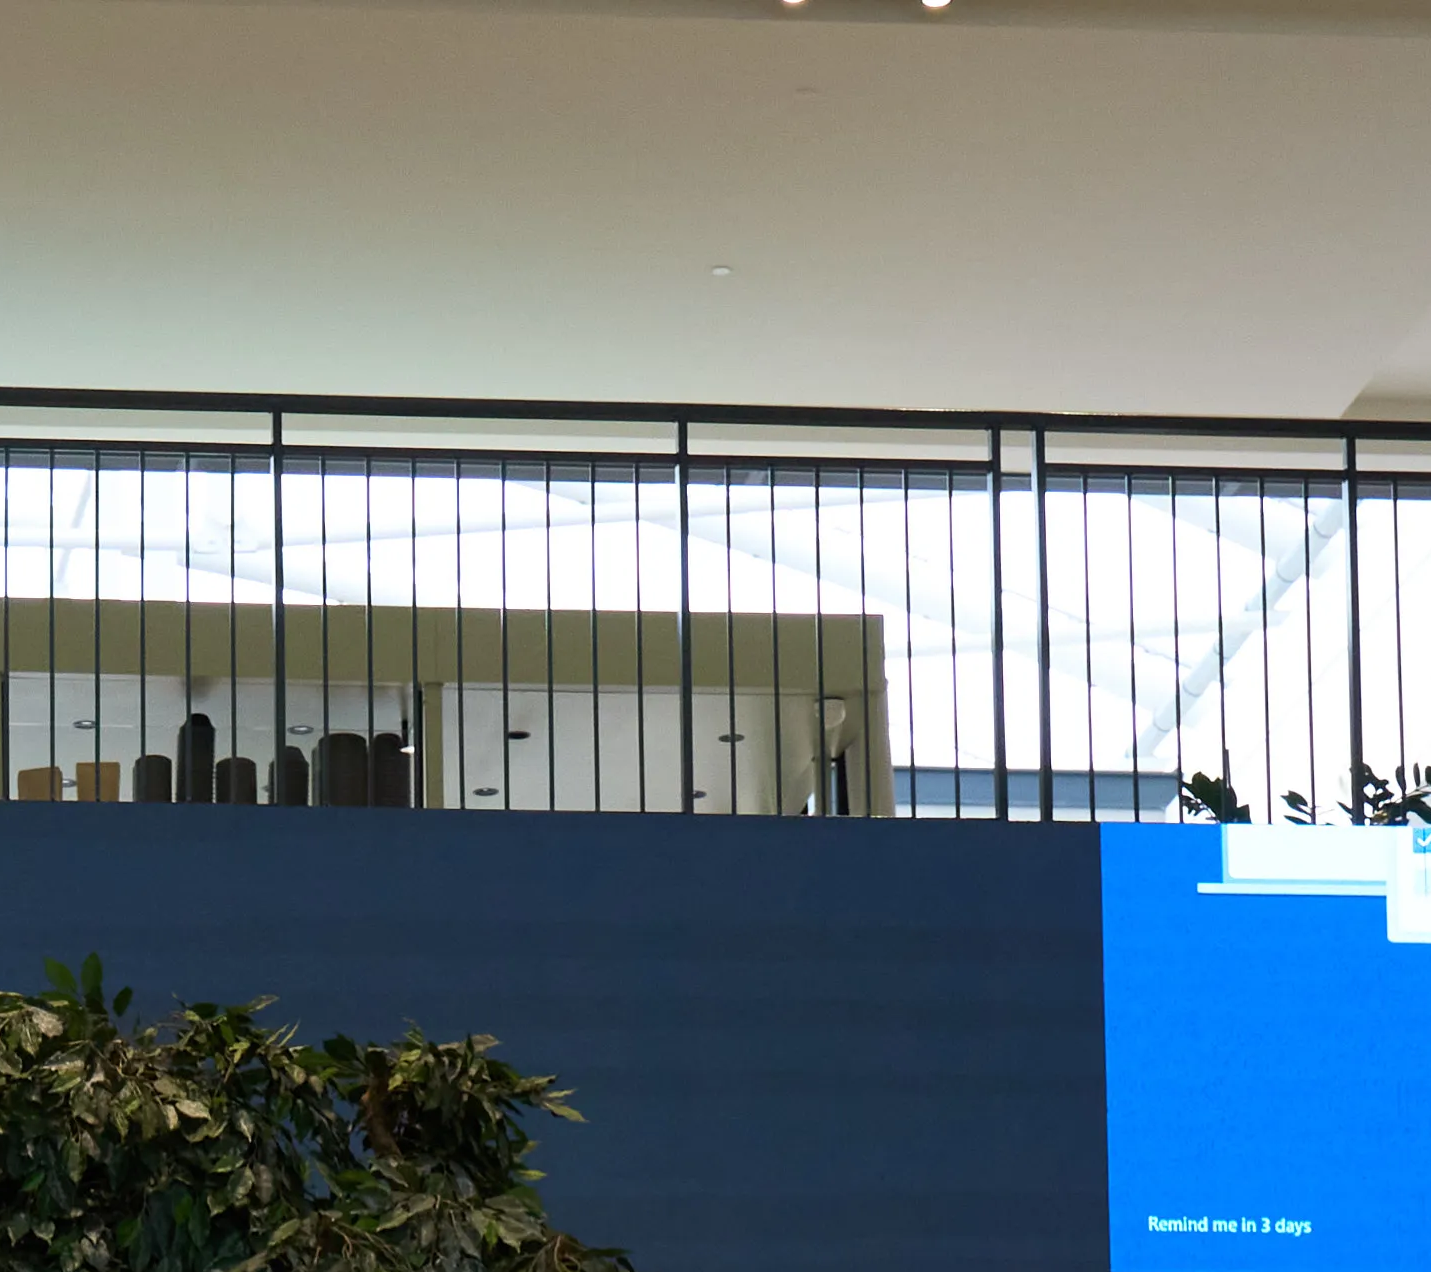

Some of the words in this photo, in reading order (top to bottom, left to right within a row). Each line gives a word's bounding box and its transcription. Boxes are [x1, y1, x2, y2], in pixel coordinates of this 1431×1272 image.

[1148, 1215, 1209, 1233] Remind
[1212, 1220, 1238, 1233] me
[1241, 1217, 1257, 1233] in
[1261, 1217, 1271, 1233] 3
[1274, 1218, 1312, 1237] days
